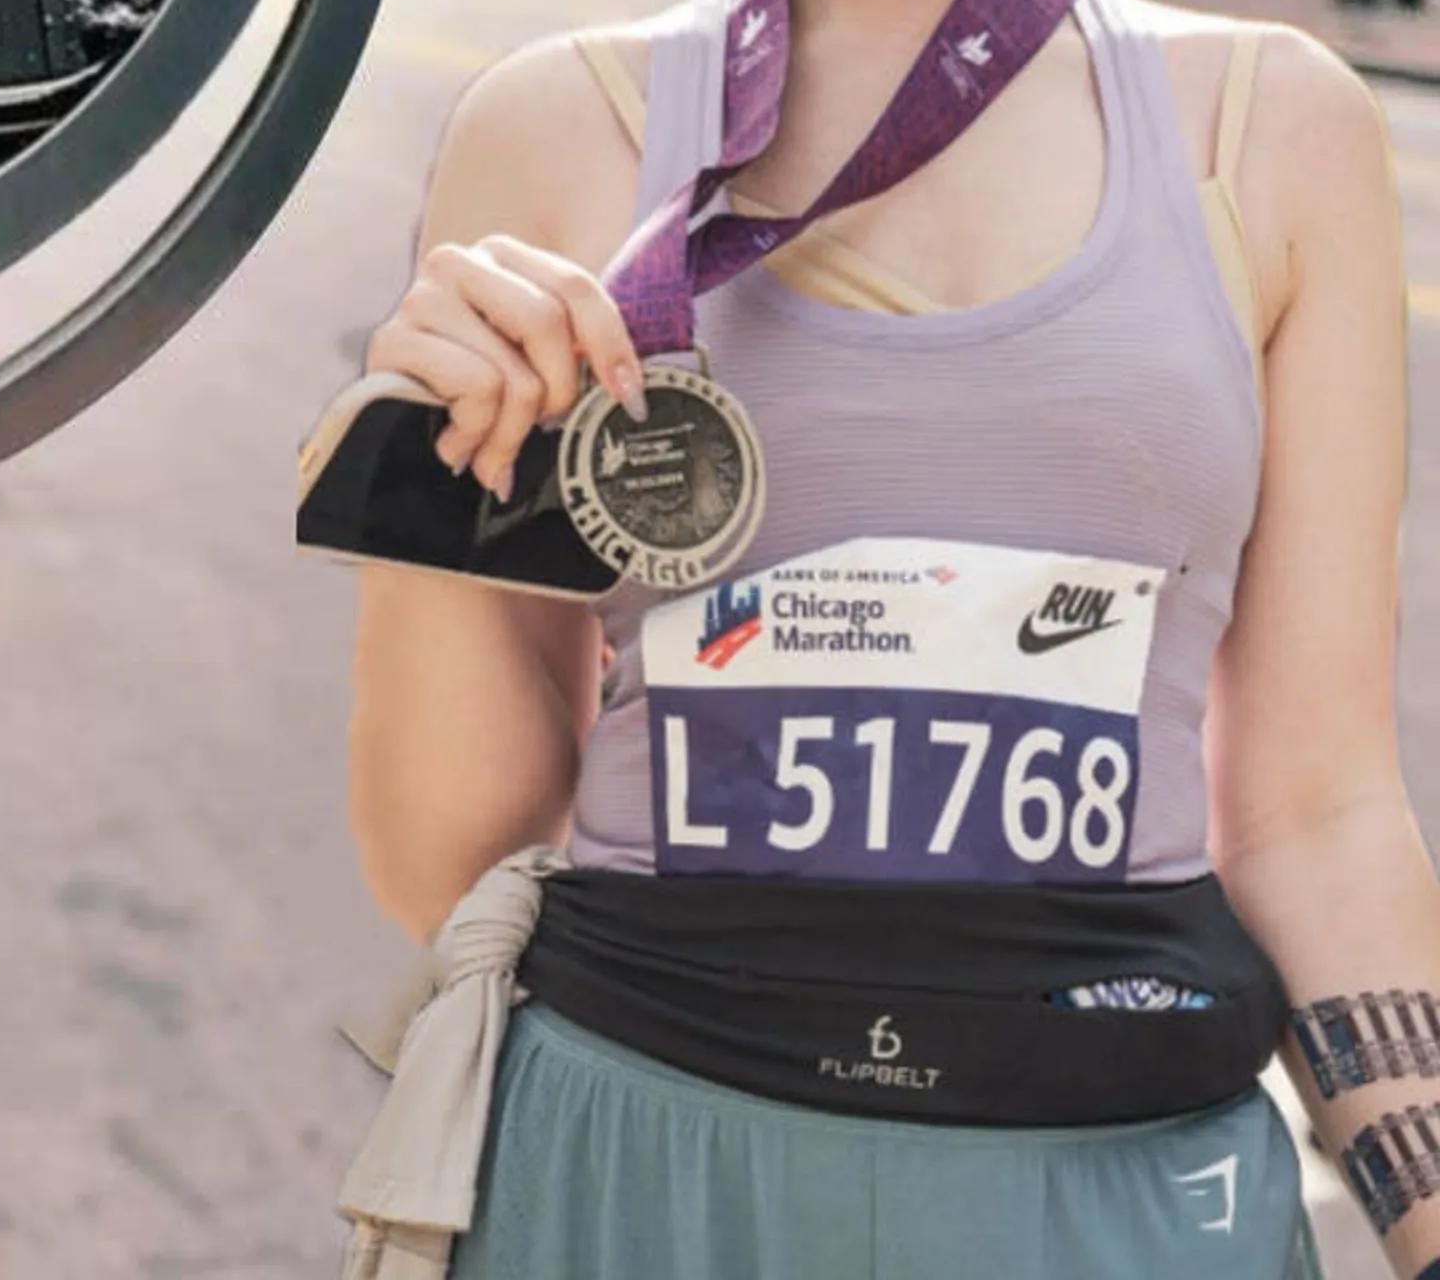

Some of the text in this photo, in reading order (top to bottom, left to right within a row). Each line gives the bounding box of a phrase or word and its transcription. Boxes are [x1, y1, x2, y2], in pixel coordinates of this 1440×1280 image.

[771, 592, 886, 627] Chicago
[1039, 582, 1116, 628] RUN
[772, 626, 912, 653] Marathon
[664, 715, 1131, 869] L 51768
[818, 1057, 942, 1089] FLIPBELT
